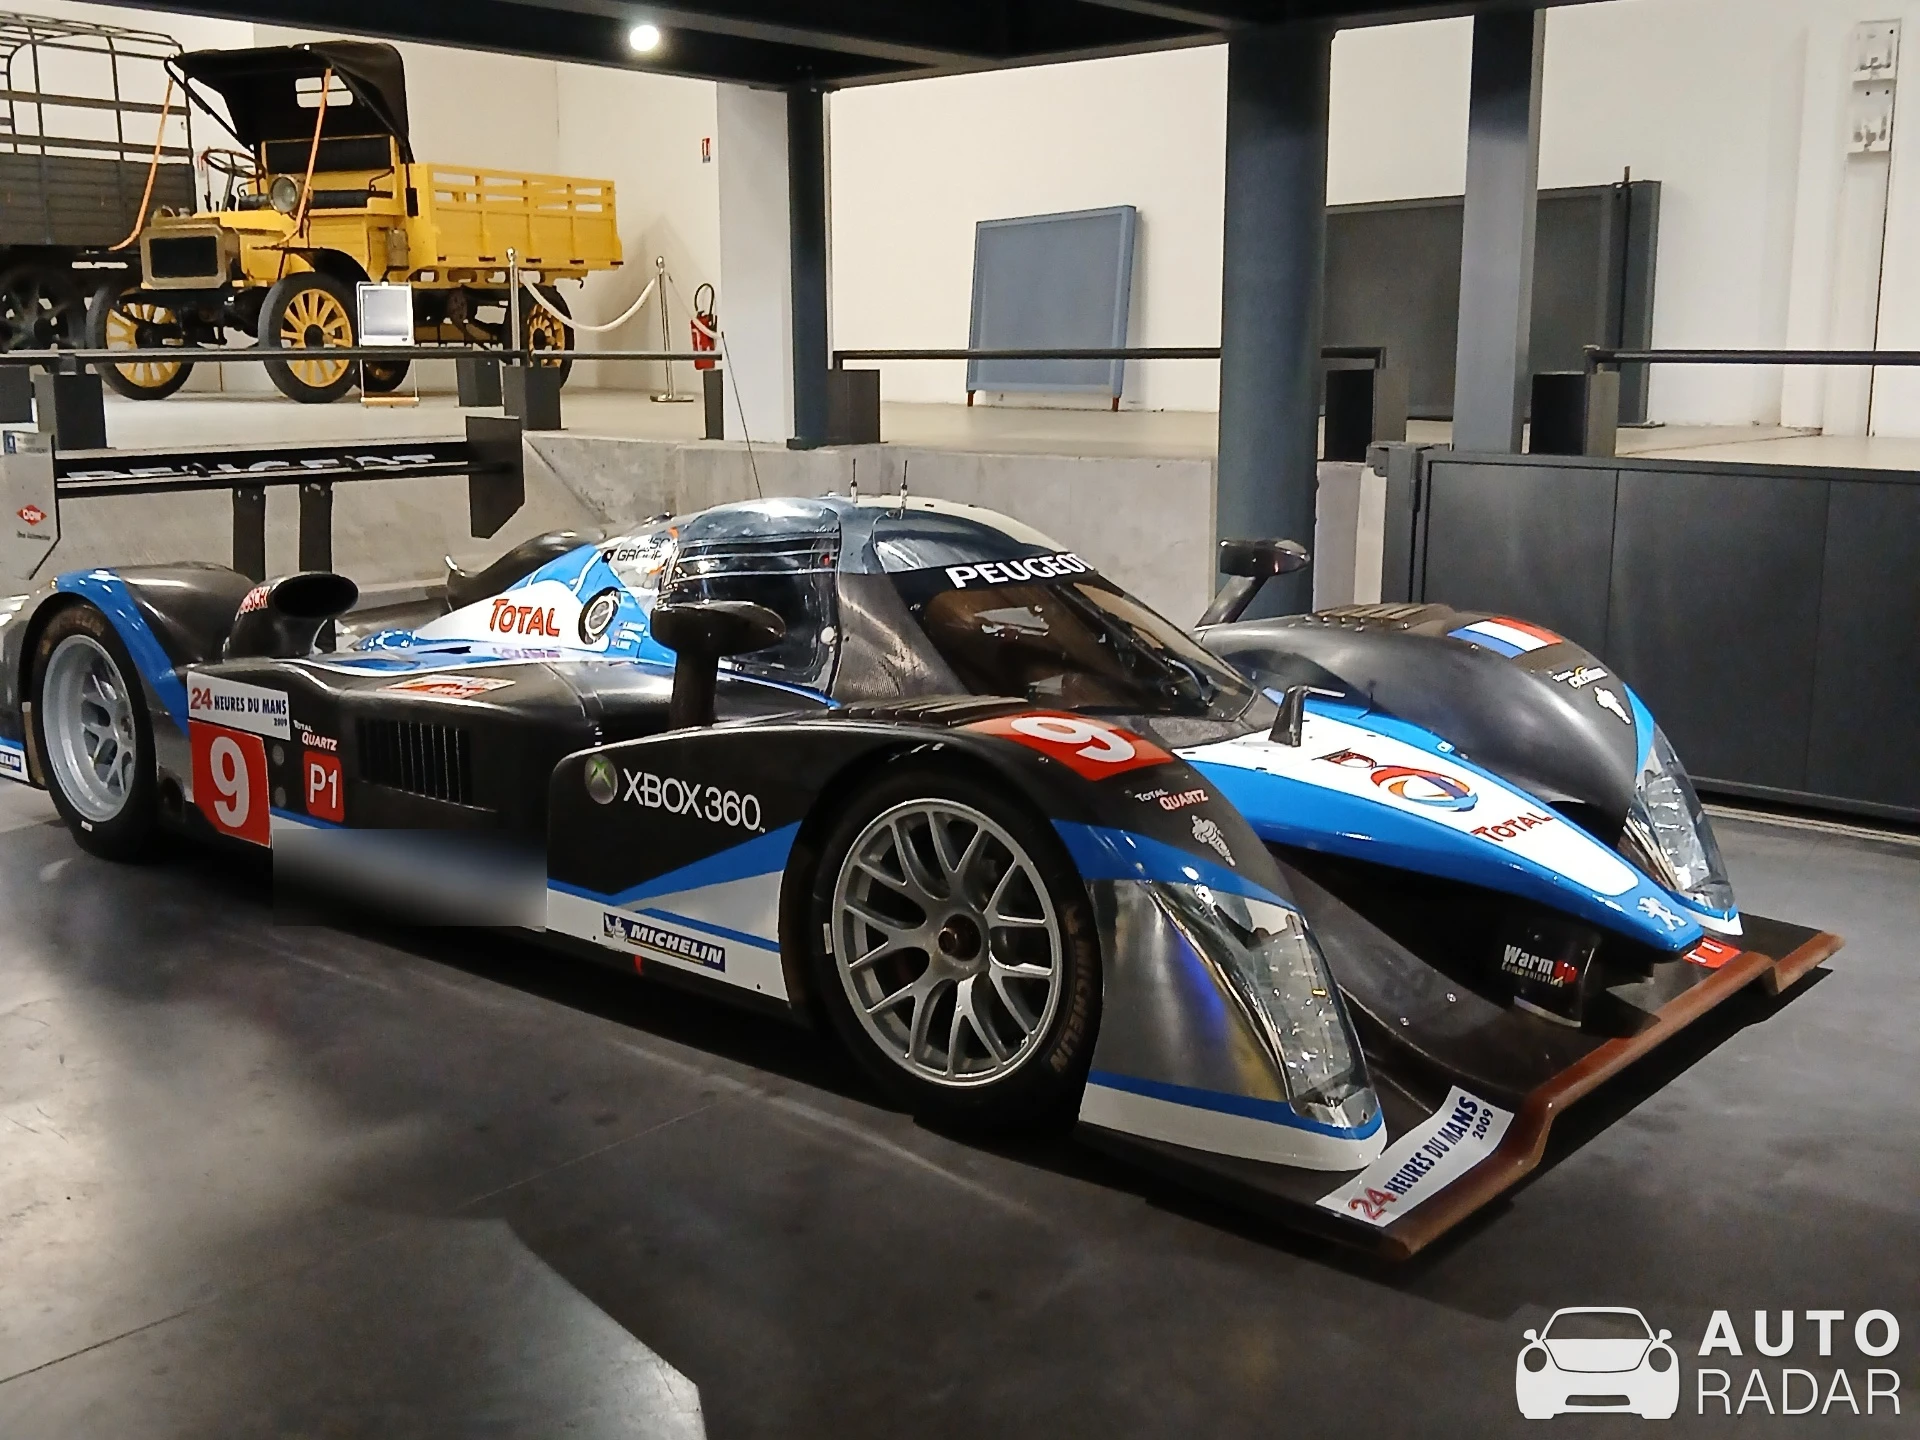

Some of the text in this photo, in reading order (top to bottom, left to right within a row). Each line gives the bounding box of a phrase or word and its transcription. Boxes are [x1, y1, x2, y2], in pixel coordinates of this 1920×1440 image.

[945, 553, 1095, 589] PEUGEOT
[489, 599, 560, 637] TOTAL
[190, 688, 287, 715] 24 HEURES DU MANS
[273, 718, 287, 727] 2009
[301, 732, 338, 751] QUARTZ
[1010, 716, 1136, 763] 9
[210, 736, 249, 828] 9
[310, 763, 338, 809] P1
[1134, 788, 1169, 802] TOTAL
[1159, 789, 1209, 811] QUARTZ
[1470, 812, 1554, 842] TOTAL
[630, 924, 723, 964] MICHELIN
[1503, 944, 1554, 975] Warm
[1472, 1108, 1494, 1140] 2009
[1348, 1096, 1478, 1221] 24 HEURES DU MANS
